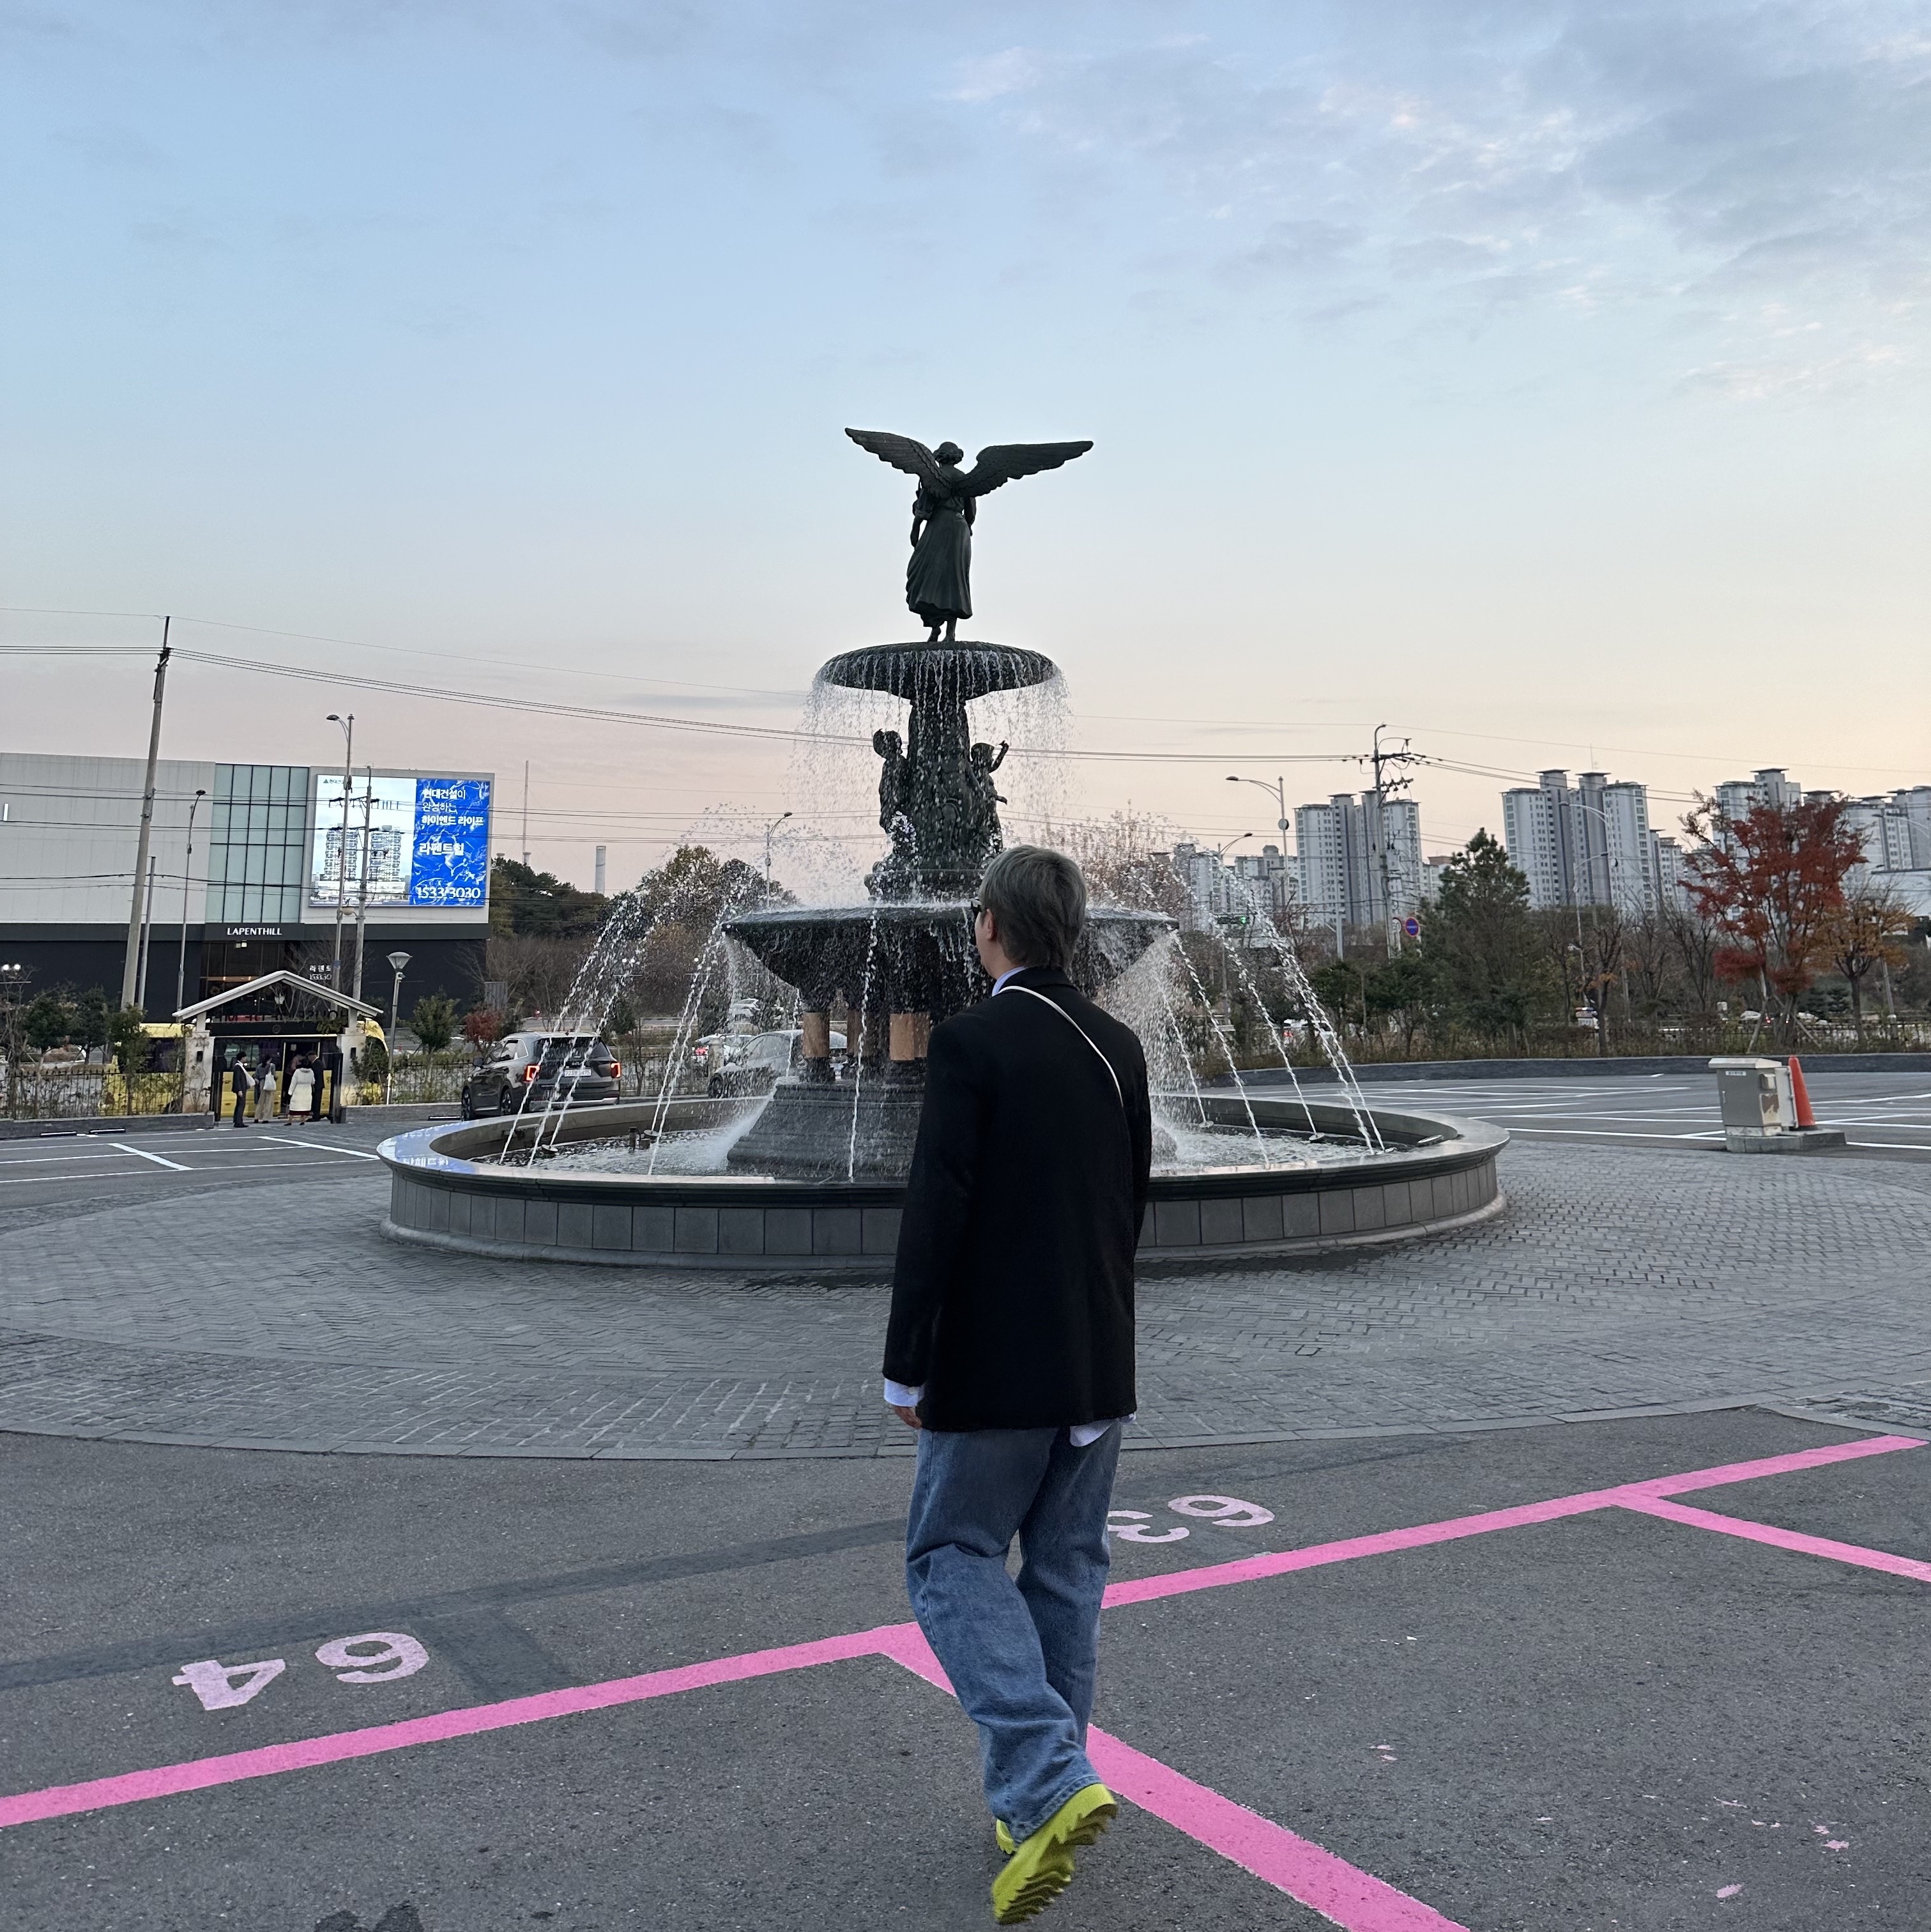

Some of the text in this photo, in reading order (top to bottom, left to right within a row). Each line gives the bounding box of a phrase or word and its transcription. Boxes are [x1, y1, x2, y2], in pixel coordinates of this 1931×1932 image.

[423, 788, 466, 800] 현대건설이
[422, 802, 457, 813] 완성하는
[422, 815, 484, 826] 하이엔드 라이프
[419, 843, 464, 856] 라펜트힐
[227, 927, 282, 935] LAPENTHILL
[172, 1632, 430, 1711] 64
